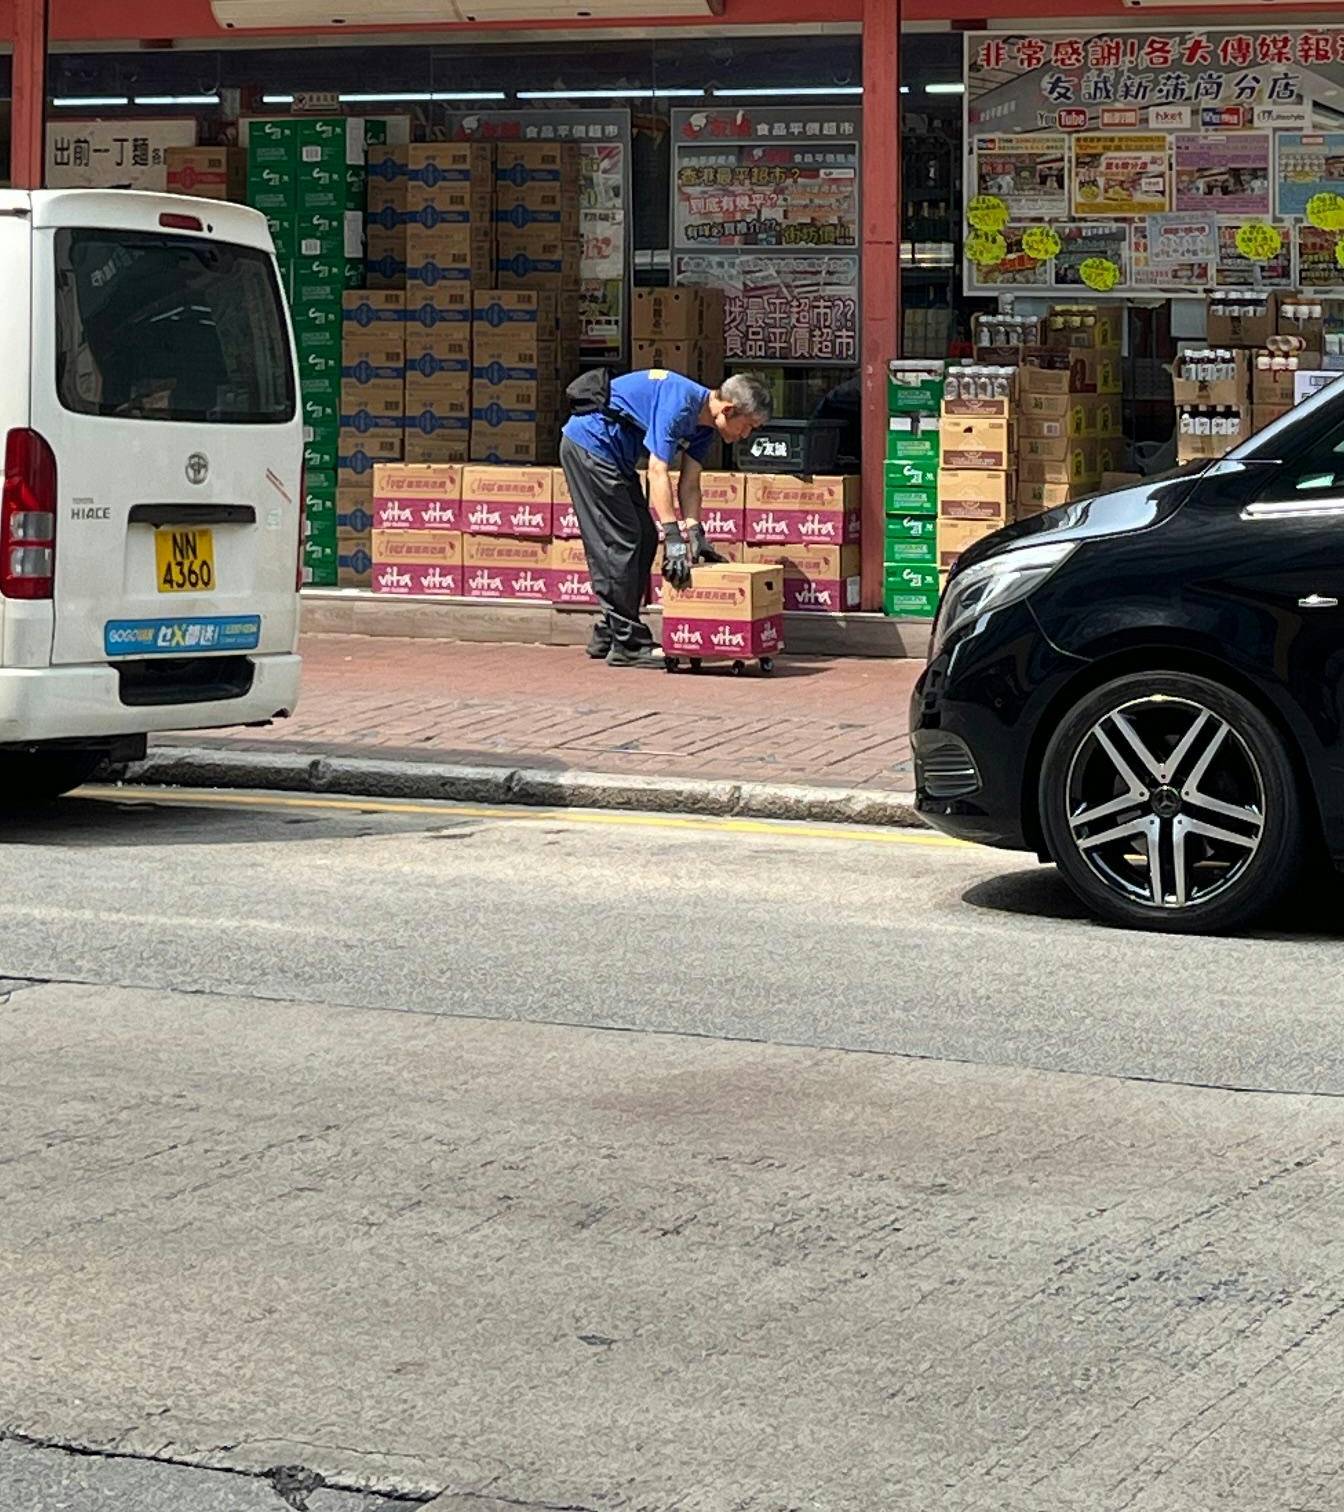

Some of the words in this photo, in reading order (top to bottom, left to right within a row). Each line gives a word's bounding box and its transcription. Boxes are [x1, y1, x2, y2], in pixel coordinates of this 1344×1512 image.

[1047, 70, 1302, 102] 友誠新蒲崗分店
[756, 122, 855, 137] 食品平價超市
[724, 327, 856, 359] 食品平價超市
[71, 506, 112, 520] HIACE
[380, 501, 413, 522] vita
[421, 502, 455, 523] vita
[468, 504, 502, 525] vita
[510, 506, 544, 528] vita
[752, 512, 789, 534] vita
[798, 514, 836, 536] vita
[172, 532, 198, 560] NN
[162, 559, 212, 590] 4360
[378, 566, 413, 588] vita
[420, 567, 455, 589] vita
[469, 569, 503, 591] vita
[511, 571, 546, 594] vita
[795, 583, 832, 606] vita
[670, 624, 704, 646] vita
[710, 625, 745, 648] vita
